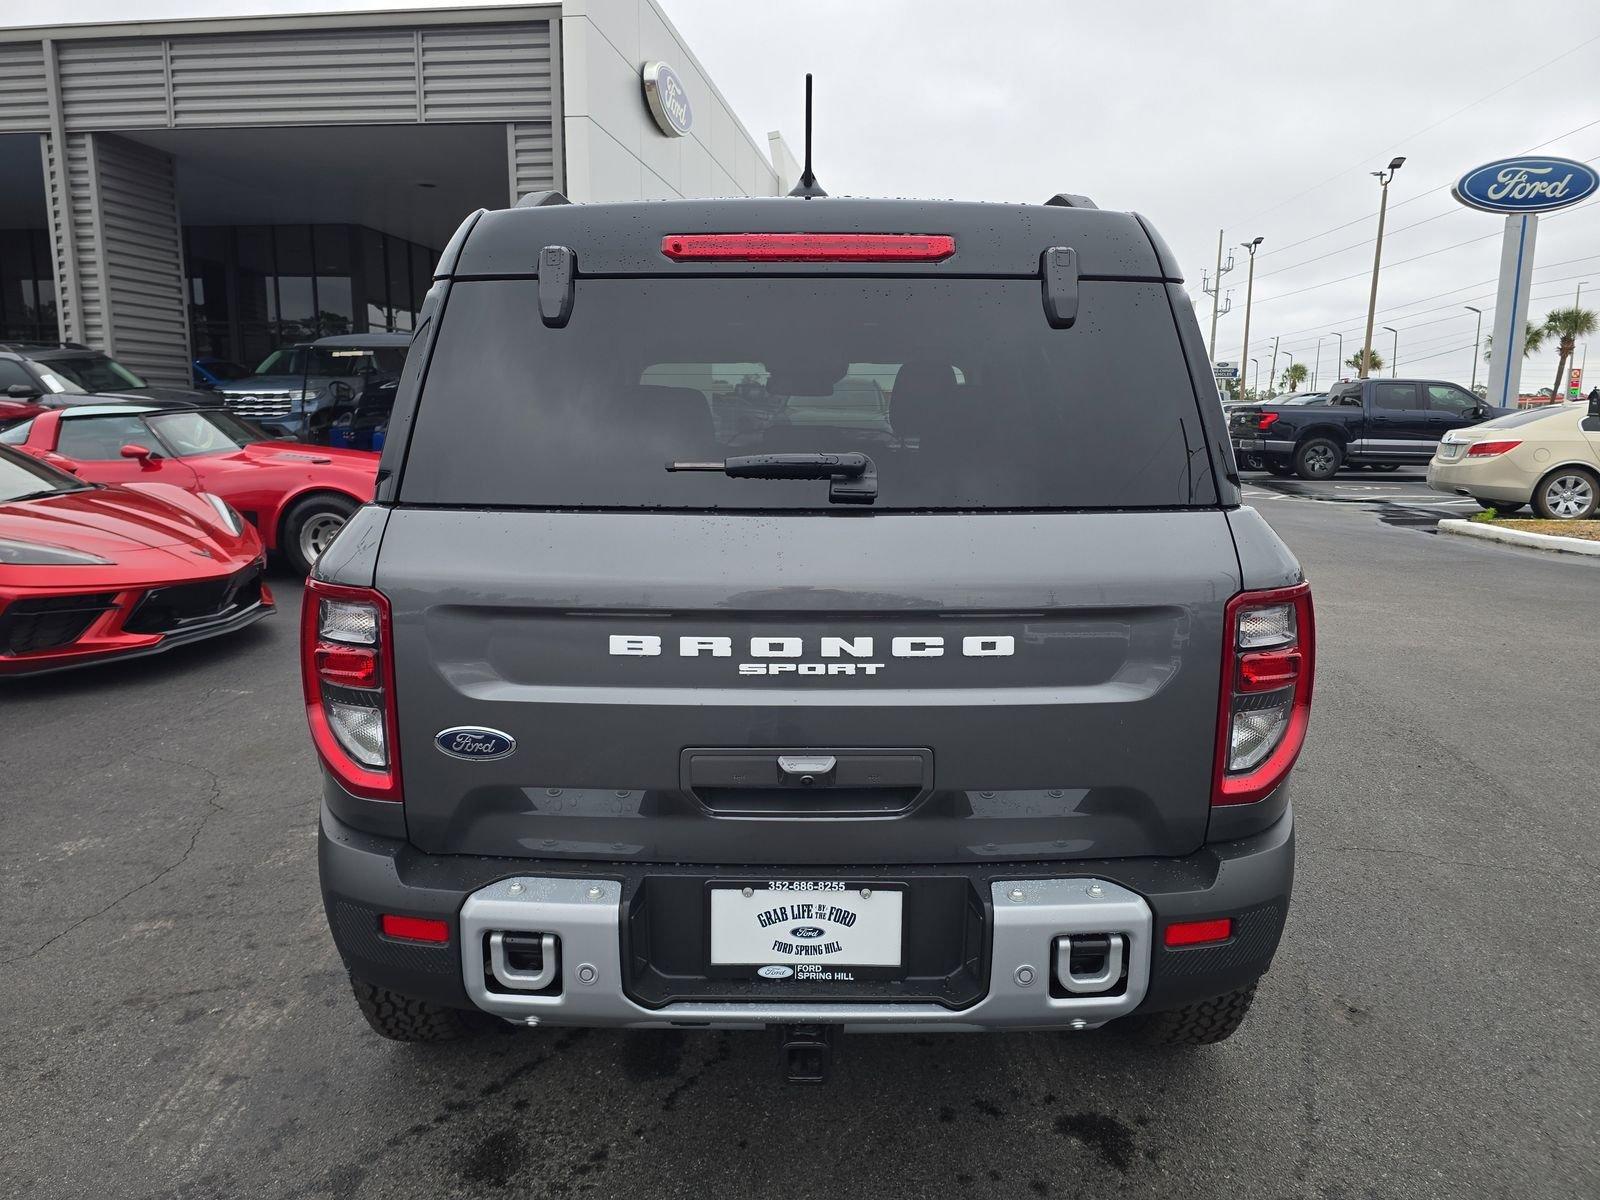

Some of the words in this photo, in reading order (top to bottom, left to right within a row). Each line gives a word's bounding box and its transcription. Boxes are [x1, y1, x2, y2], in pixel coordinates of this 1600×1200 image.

[665, 76, 687, 126] Ford
[1487, 167, 1573, 200] Ford
[609, 635, 1015, 657] BRONCO
[738, 663, 885, 675] SPORT
[452, 733, 496, 753] Ford
[768, 881, 846, 891] 352-686-8255
[757, 906, 789, 928] GRAB
[790, 903, 813, 919] LIFE
[815, 911, 827, 920] THE
[827, 906, 857, 927] FORD
[796, 927, 819, 937] Ford
[772, 940, 794, 955] FORD
[795, 942, 824, 956] SPRING
[824, 941, 842, 953] HILL
[764, 967, 788, 977] Ford
[797, 964, 822, 972] FORD
[797, 972, 832, 980] SPRING
[834, 972, 854, 981] HILL
